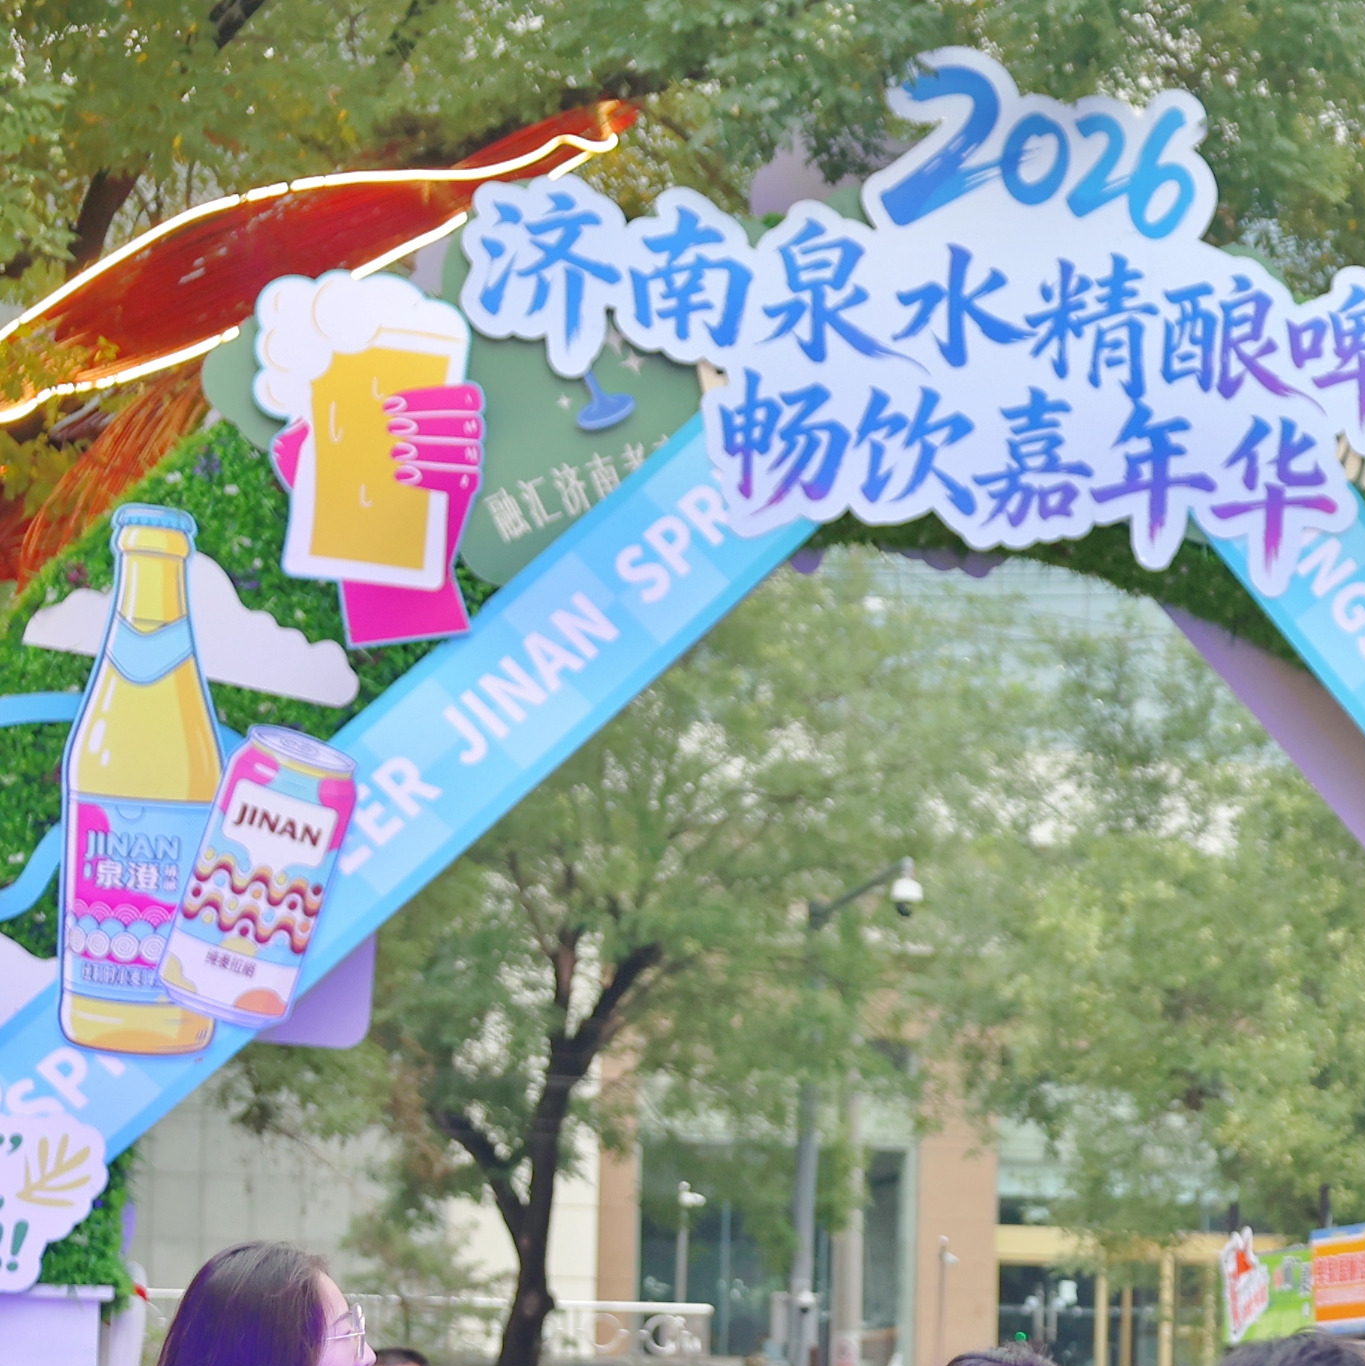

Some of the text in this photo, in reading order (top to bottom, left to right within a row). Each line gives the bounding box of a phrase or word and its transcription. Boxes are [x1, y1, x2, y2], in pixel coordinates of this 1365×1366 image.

[878, 64, 1199, 240] 2026
[718, 366, 1338, 567] 畅饮嘉年华
[441, 592, 620, 764] JINAN
[85, 829, 181, 860] JINAN
[234, 803, 322, 847] JINAN
